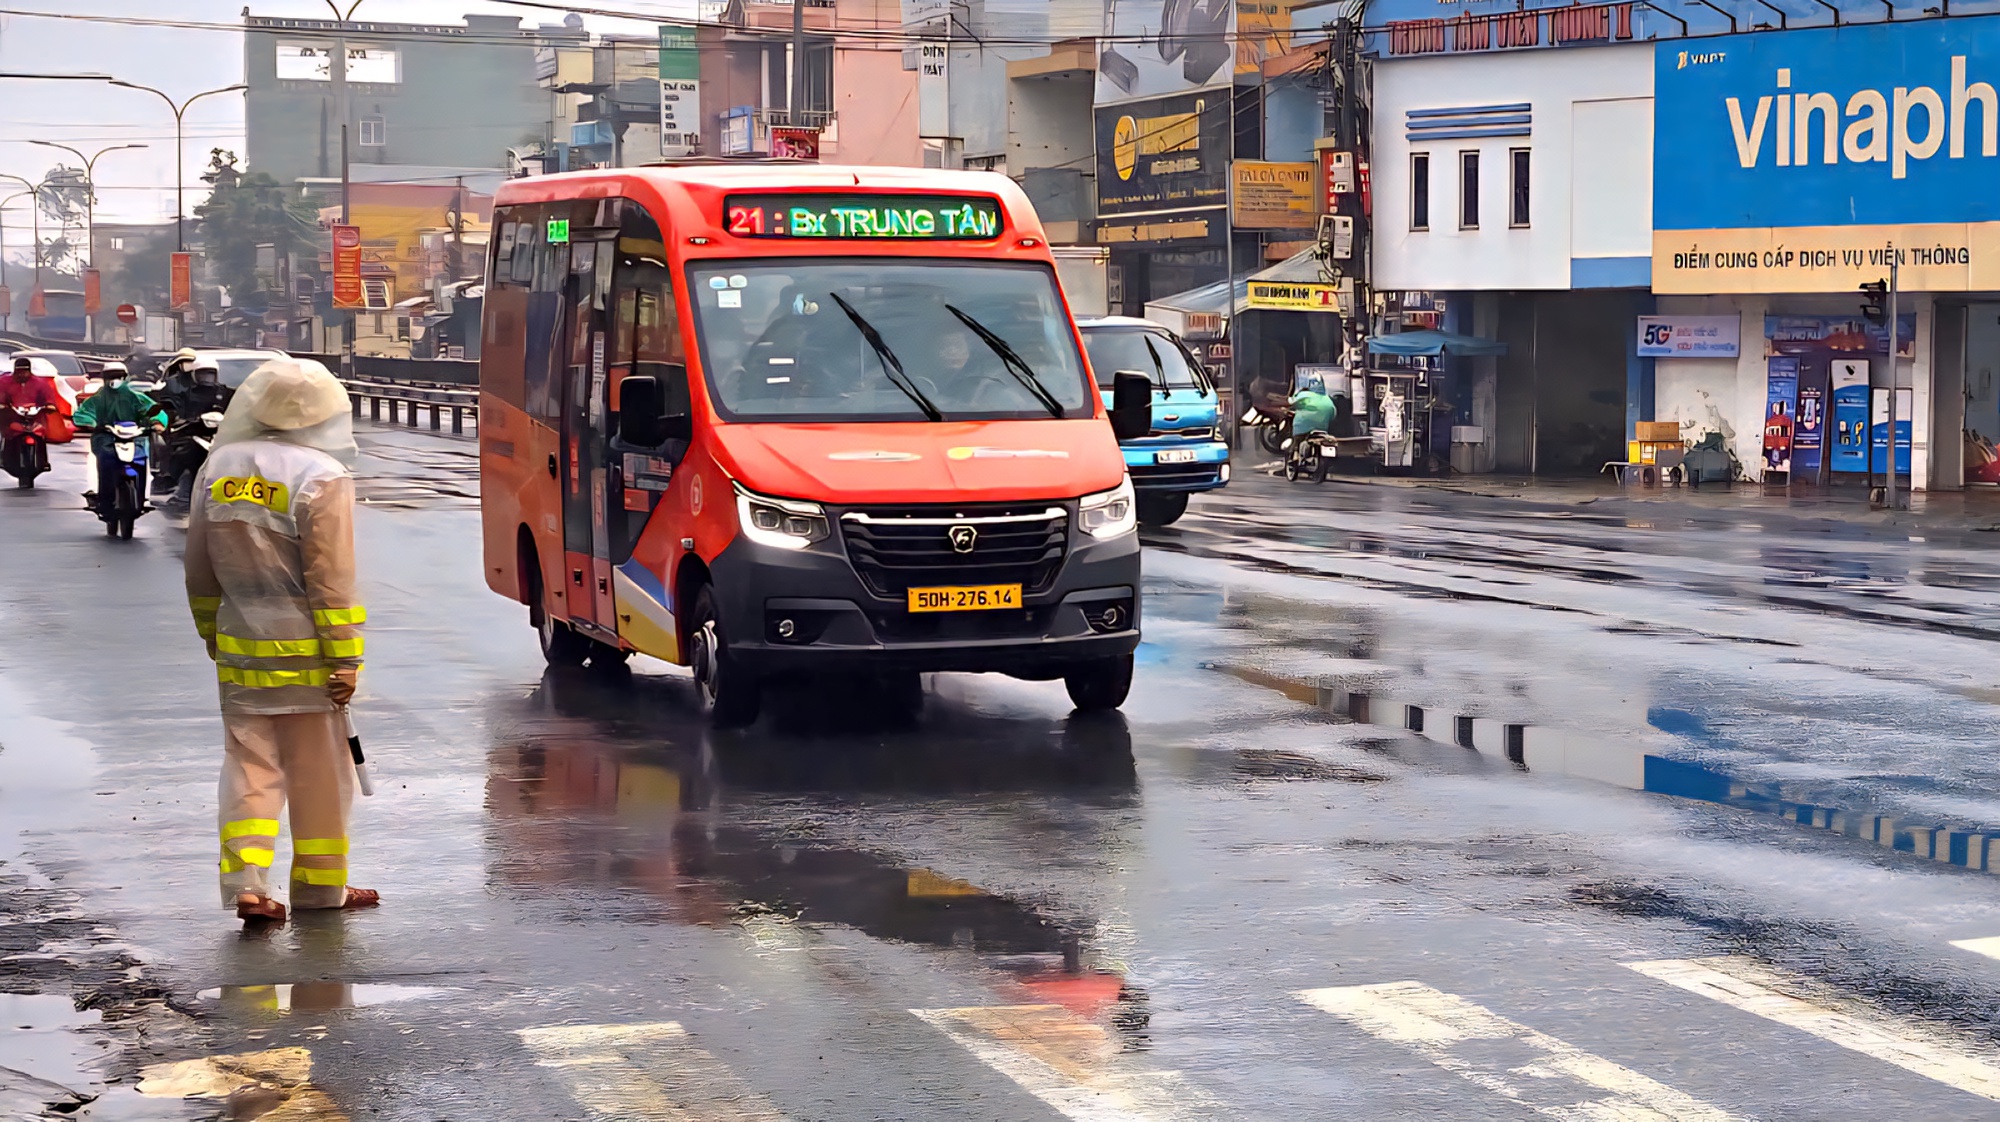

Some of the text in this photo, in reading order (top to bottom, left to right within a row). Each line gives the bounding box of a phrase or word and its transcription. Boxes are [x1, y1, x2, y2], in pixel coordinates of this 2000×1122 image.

[1690, 52, 1726, 64] VNPT
[1725, 55, 1998, 180] vinaph
[729, 207, 765, 235] 21
[830, 207, 936, 236] TRUNG
[1673, 241, 1970, 271] ĐIỂM CUNG CẤP DỊCH VỤ VIỄN THÔNG
[1643, 324, 1670, 346] 5G
